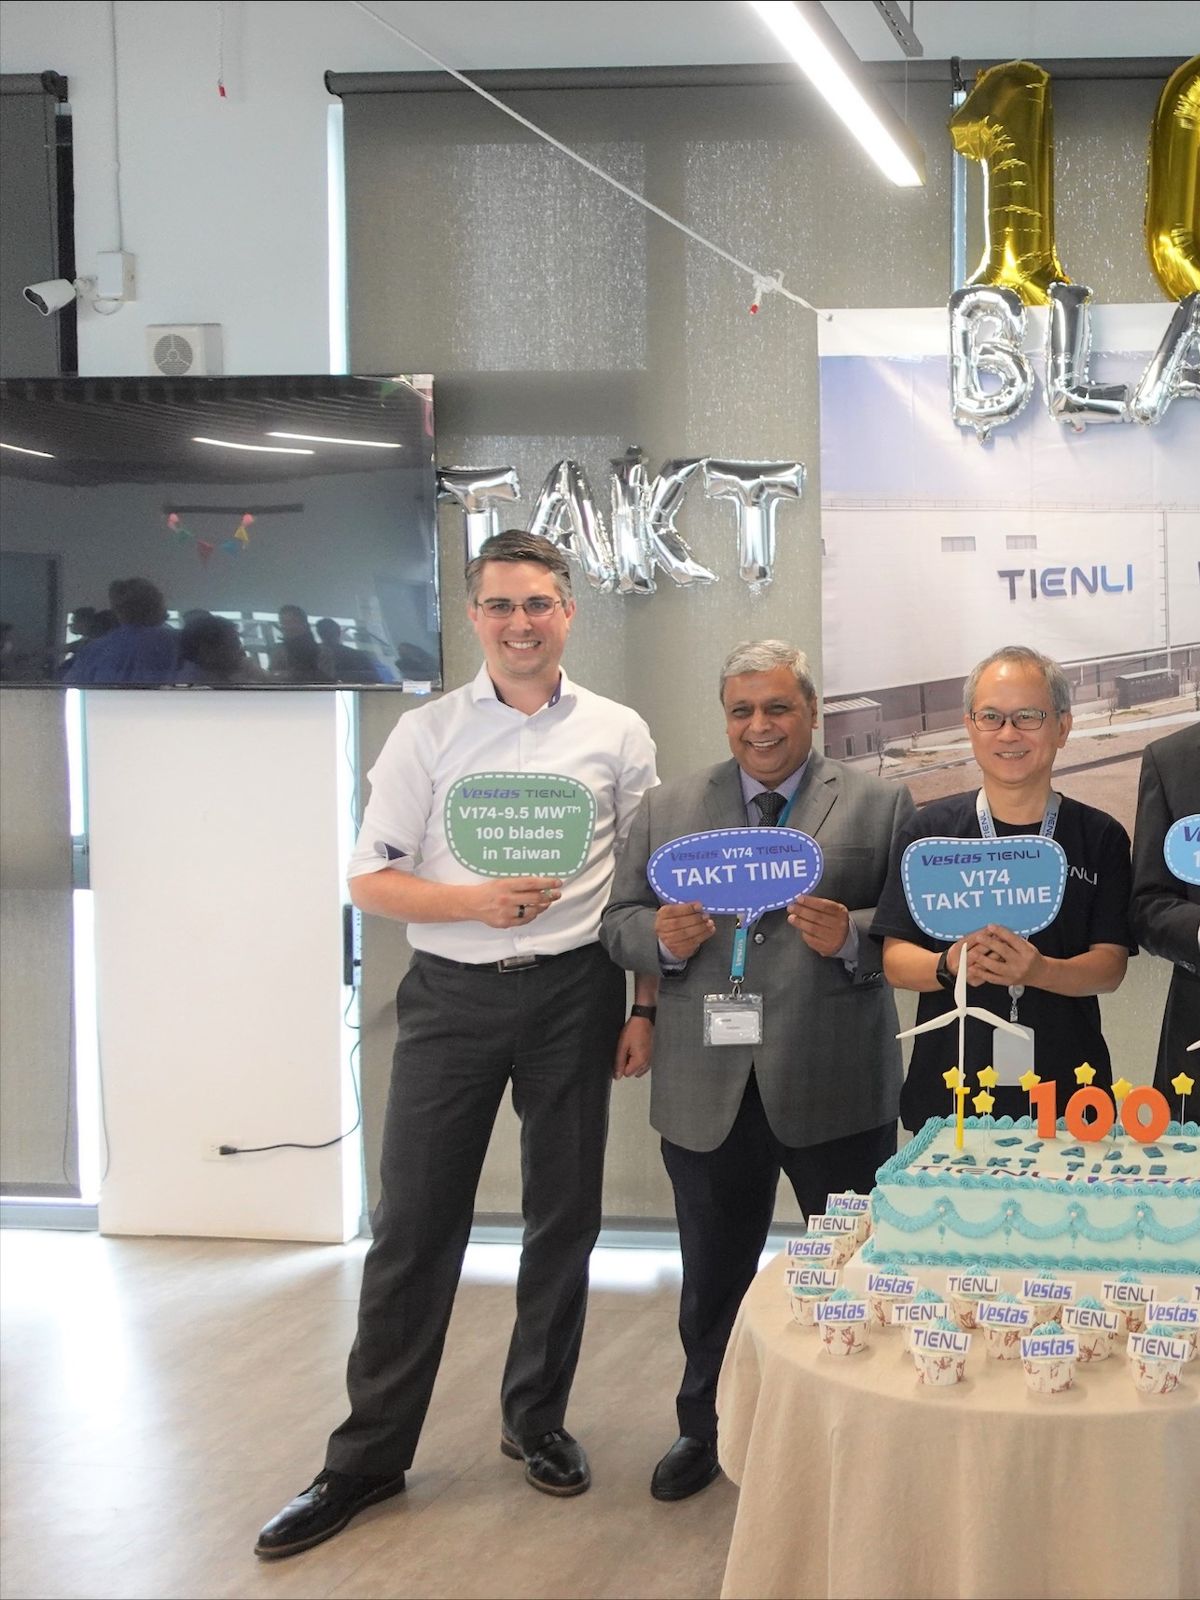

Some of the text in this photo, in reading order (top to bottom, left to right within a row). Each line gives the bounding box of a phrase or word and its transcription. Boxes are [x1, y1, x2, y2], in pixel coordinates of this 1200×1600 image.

[437, 447, 807, 594] TAKT
[997, 564, 1133, 600] TIENLI
[462, 788, 576, 799] Vestas TIENLI
[459, 806, 529, 819] V174-9.5
[476, 826, 564, 839] 100 blades
[483, 846, 561, 859] in Taiwan
[670, 844, 803, 861] Vestas V174 TIENLI
[921, 850, 1040, 866] Vestas TIENLI
[672, 859, 807, 887] TAKT TIME
[960, 869, 1010, 888] V174
[922, 886, 1052, 911] TAKT TIME
[1029, 1080, 1170, 1143] 100
[932, 1154, 1167, 1175] TAKT TIME
[827, 1195, 869, 1211] Vestas
[810, 1217, 856, 1231] TIENLI
[787, 1240, 832, 1256] Vestas
[787, 1270, 836, 1286] TIENLI
[868, 1274, 915, 1295] Vestas
[949, 1277, 998, 1293] TIENLI
[1024, 1281, 1072, 1300] Vestas
[1104, 1284, 1154, 1302] TIENLI
[817, 1303, 865, 1321] Vestas
[895, 1305, 948, 1321] TIENLI
[979, 1305, 1029, 1325] Vestas
[1065, 1309, 1118, 1330] TIENLI
[1149, 1304, 1199, 1324] Vestas
[914, 1329, 969, 1351] TIENLI
[1022, 1338, 1075, 1357] Vestas
[1131, 1336, 1187, 1359] TIENLI
